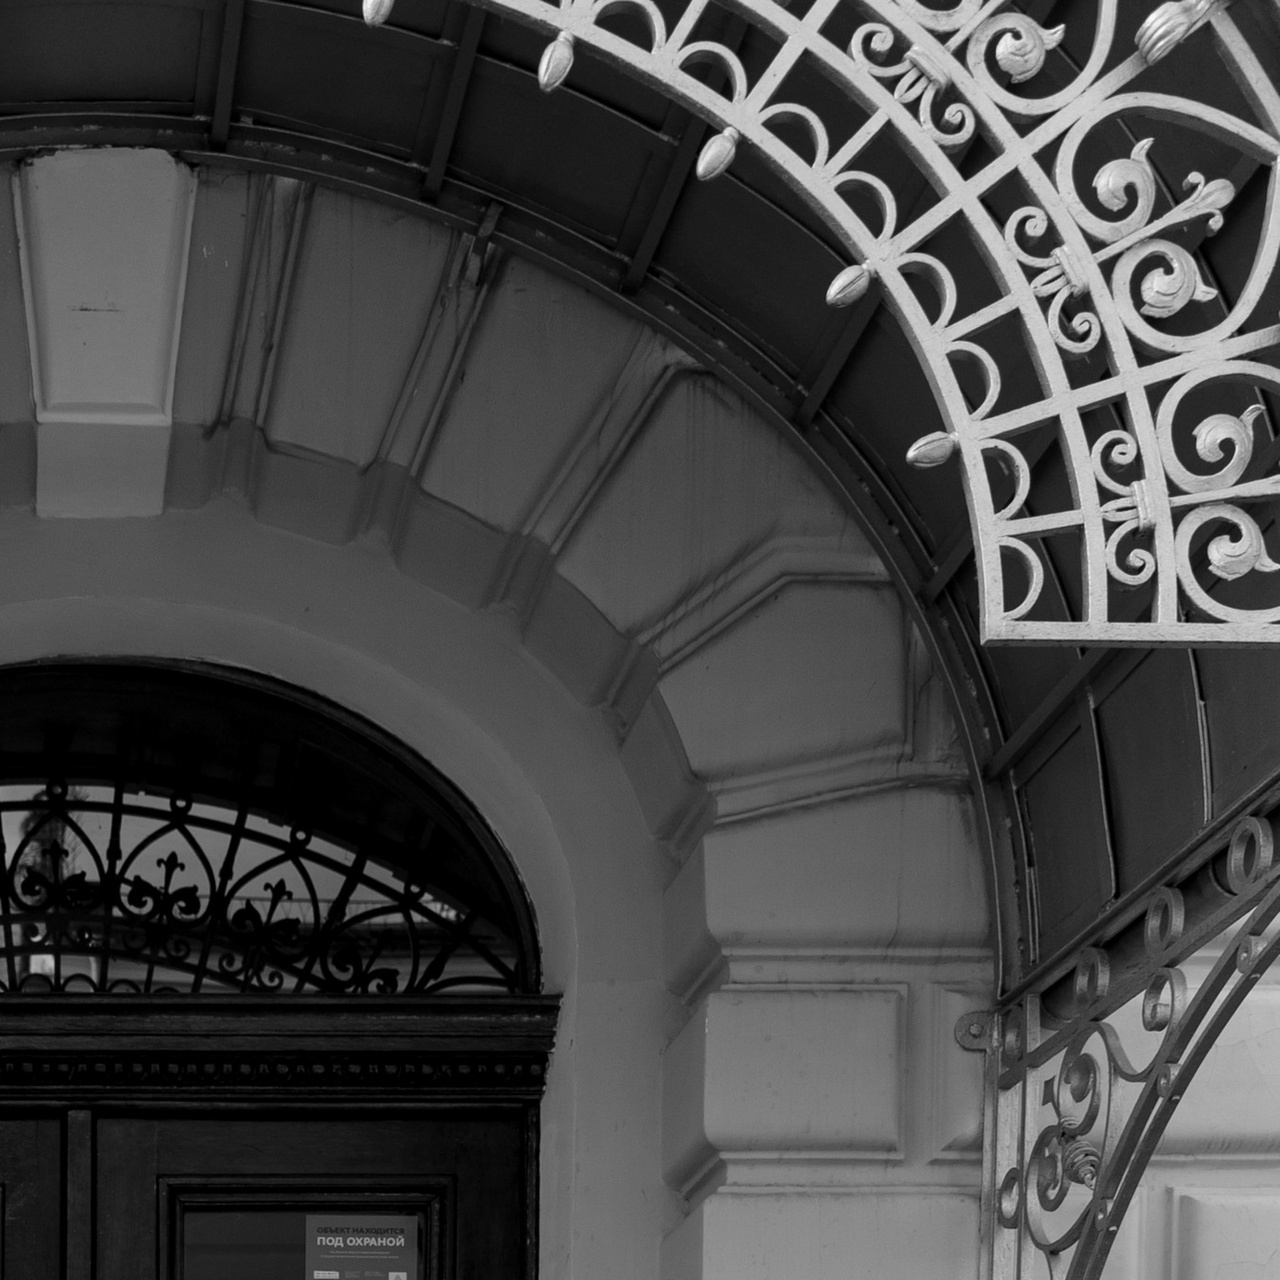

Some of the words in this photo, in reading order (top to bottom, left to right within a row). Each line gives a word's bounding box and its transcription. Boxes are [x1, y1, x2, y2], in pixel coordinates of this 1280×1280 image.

[317, 1227, 351, 1235] ОБЪЕКТ
[352, 1227, 405, 1236] НАХОДИТСЯ
[316, 1236, 344, 1248] ПОД
[346, 1235, 405, 1247] ОХРАНОЙ
